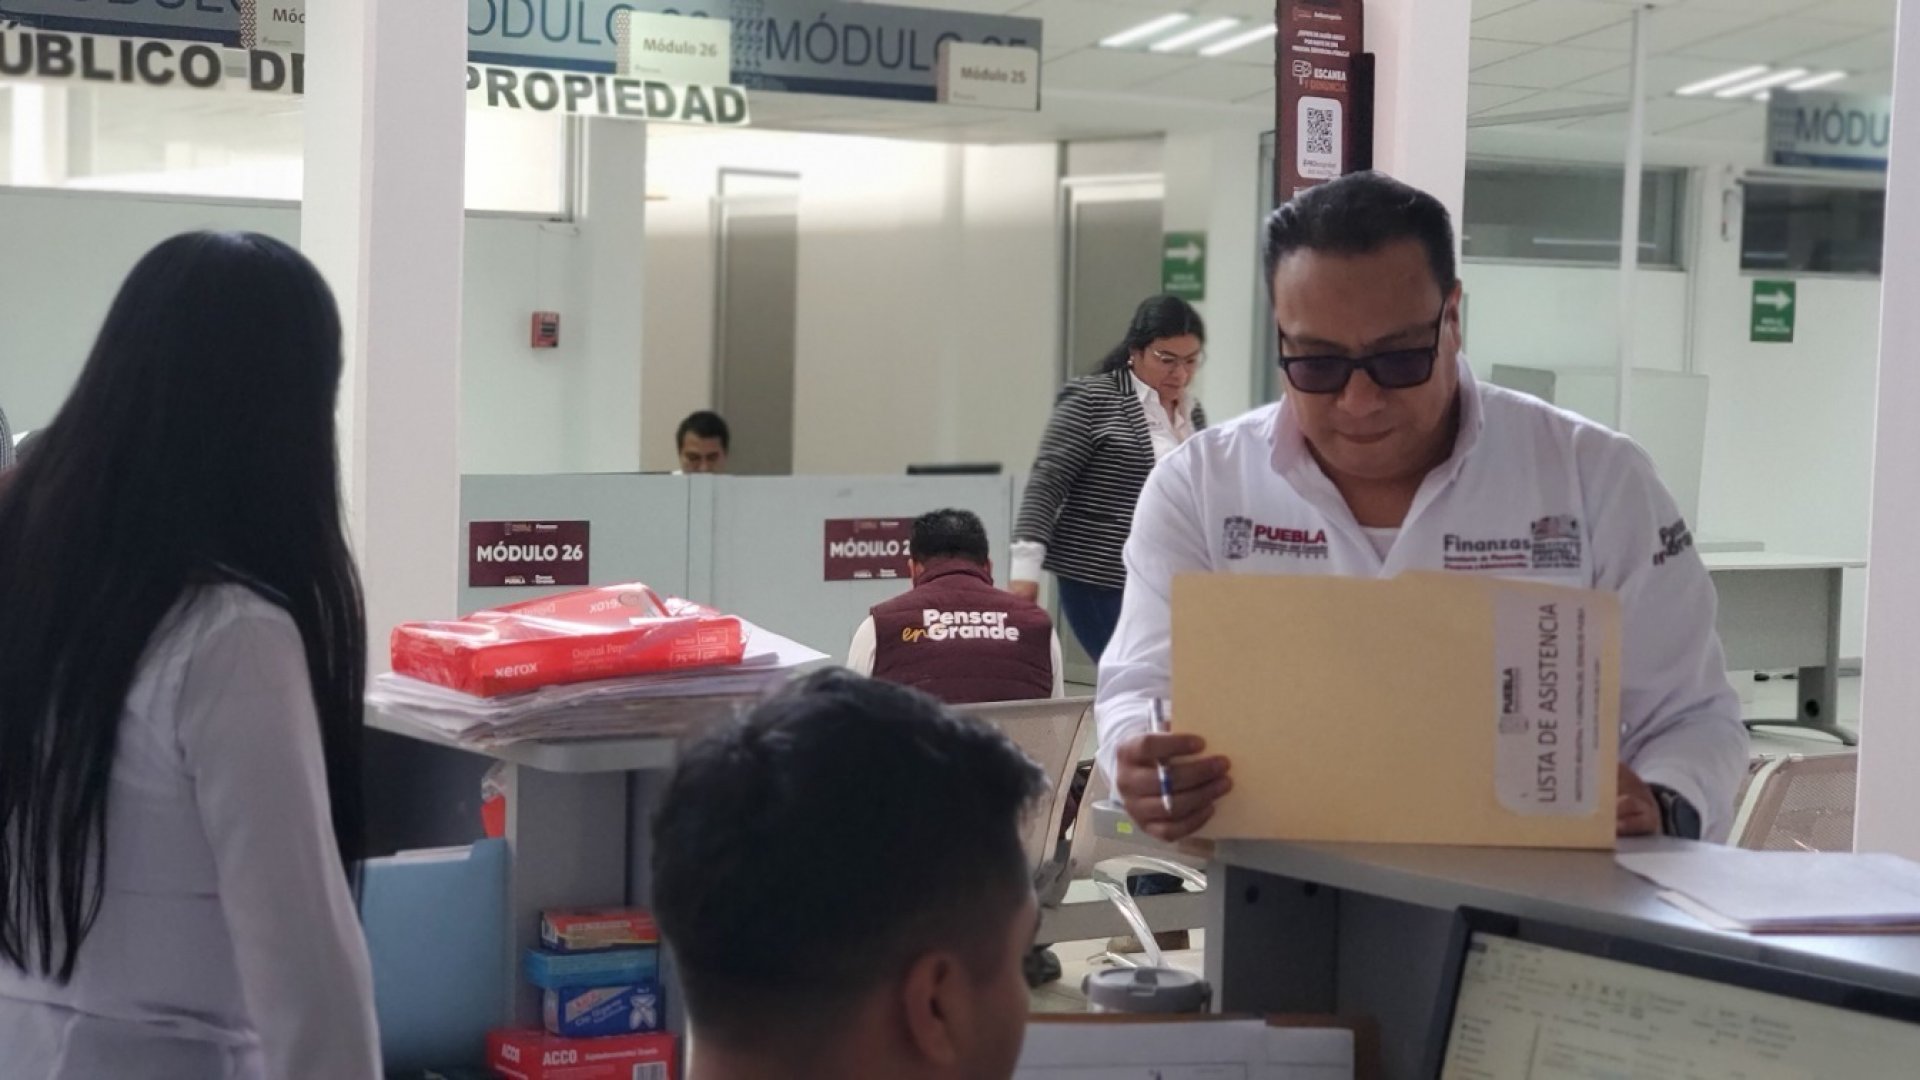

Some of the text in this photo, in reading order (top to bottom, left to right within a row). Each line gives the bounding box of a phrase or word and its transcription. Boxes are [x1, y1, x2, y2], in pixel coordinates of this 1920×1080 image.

[643, 38, 718, 58] Módulo 26
[961, 66, 1008, 83] Módulo
[1254, 524, 1328, 544] PUEBLA
[1444, 534, 1531, 552] Finanzas
[477, 541, 583, 562] MÓDULO 26
[830, 537, 899, 558] MÓDULO
[923, 609, 1008, 626] Pensar
[902, 623, 1020, 642] en Grande
[494, 662, 538, 679] xerox
[1503, 667, 1514, 715] PUEBLA
[1537, 603, 1559, 803] LISTA DE ASISTENCIA
[542, 1050, 577, 1066] ACCO
